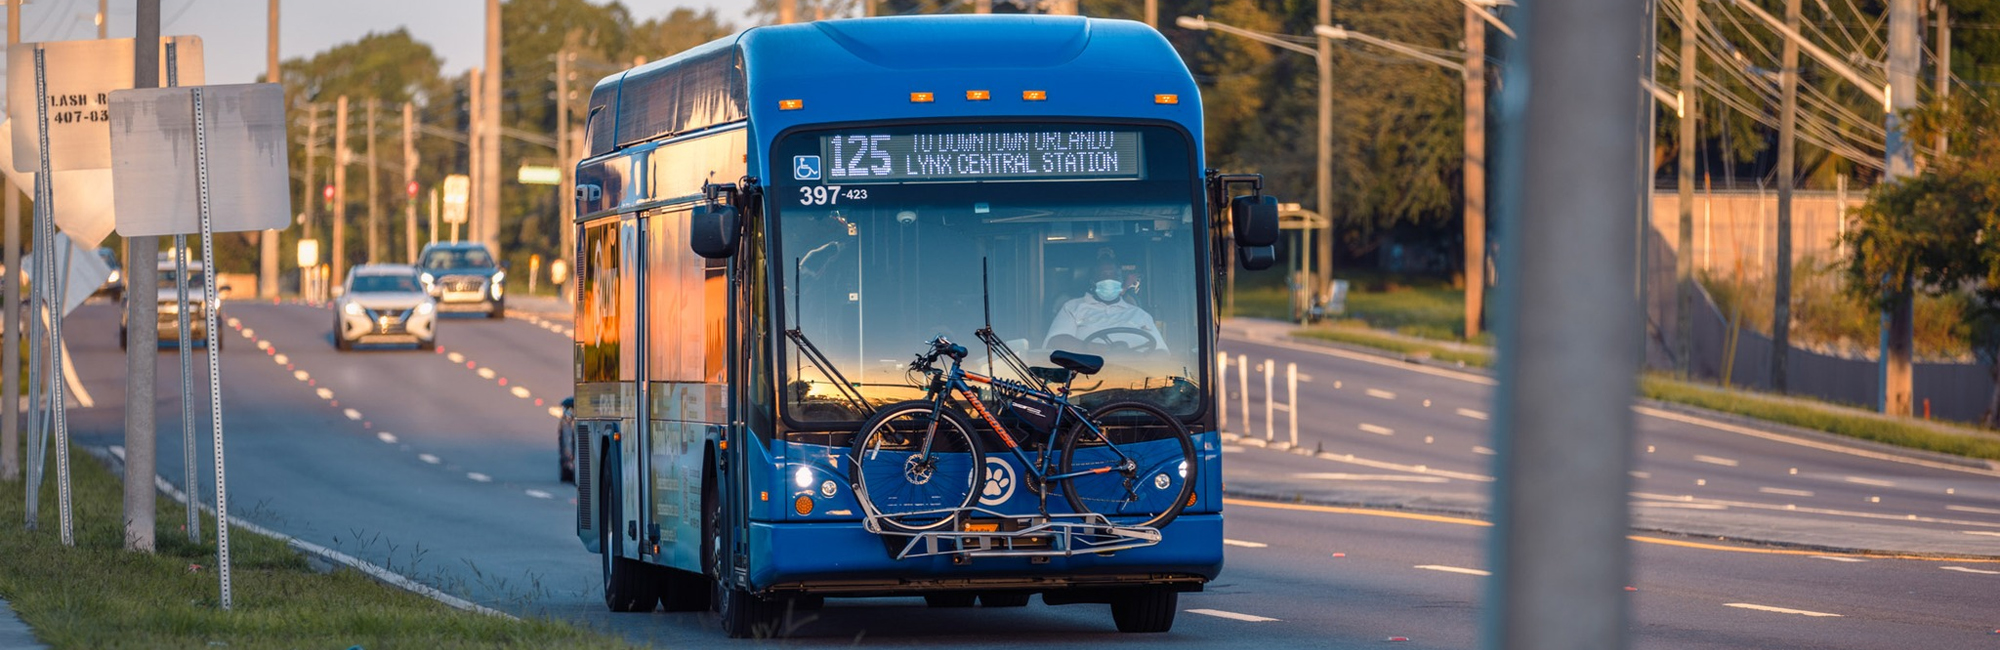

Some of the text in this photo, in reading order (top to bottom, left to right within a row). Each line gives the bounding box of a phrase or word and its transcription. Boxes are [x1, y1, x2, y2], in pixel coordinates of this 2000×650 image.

[47, 94, 87, 106] LASH
[54, 110, 109, 124] 407-83
[914, 131, 1114, 153] TO DOWNTOWN ORLANDO
[831, 134, 892, 176] 125
[906, 151, 1119, 175] LYNX CENTRAL STATION
[963, 389, 1018, 448] MONGOOSE
